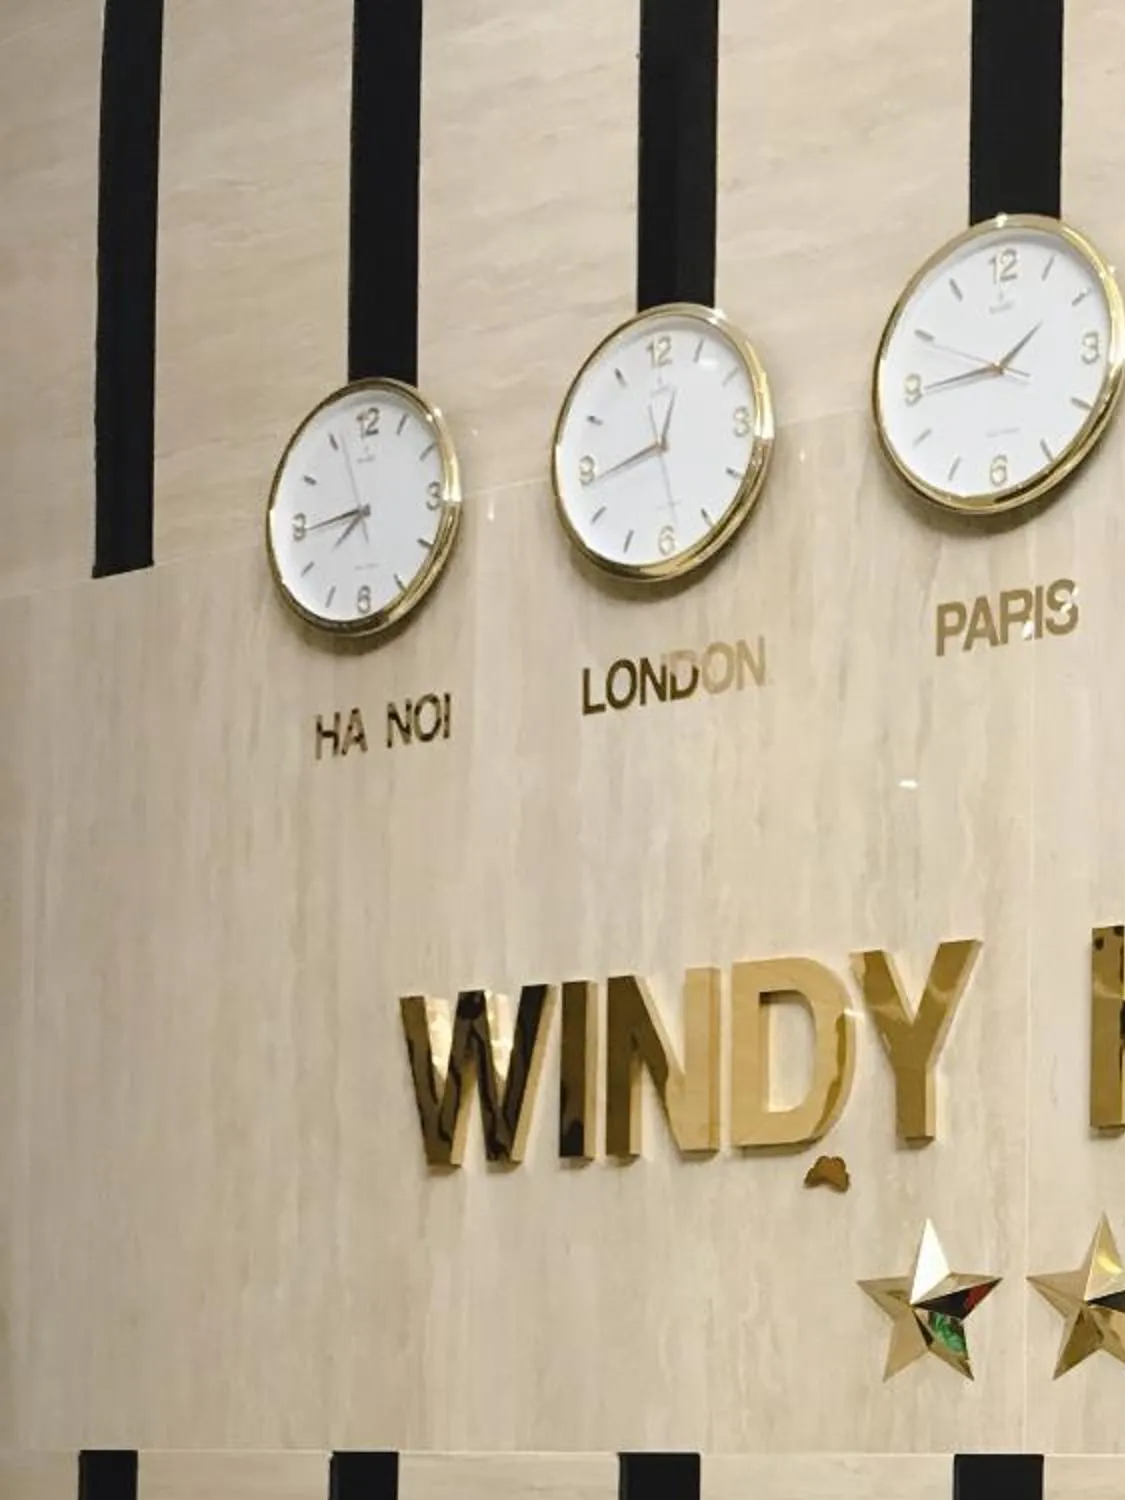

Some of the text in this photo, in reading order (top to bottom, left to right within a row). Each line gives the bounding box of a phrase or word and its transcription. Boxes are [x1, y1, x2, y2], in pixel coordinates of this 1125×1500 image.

[988, 249, 1018, 284] 12
[646, 335, 673, 368] 12
[1081, 331, 1100, 365] 3
[904, 373, 923, 407] 9
[356, 407, 380, 439] 12
[732, 406, 750, 438] 3
[578, 455, 596, 487] 9
[989, 455, 1008, 488] 6
[426, 481, 442, 511] 3
[658, 525, 675, 557] 6
[357, 585, 371, 615] 6
[935, 578, 1080, 657] PARIS
[582, 635, 767, 716] LONDON
[314, 692, 452, 761] HA NOI
[400, 939, 982, 1168] WINDY
